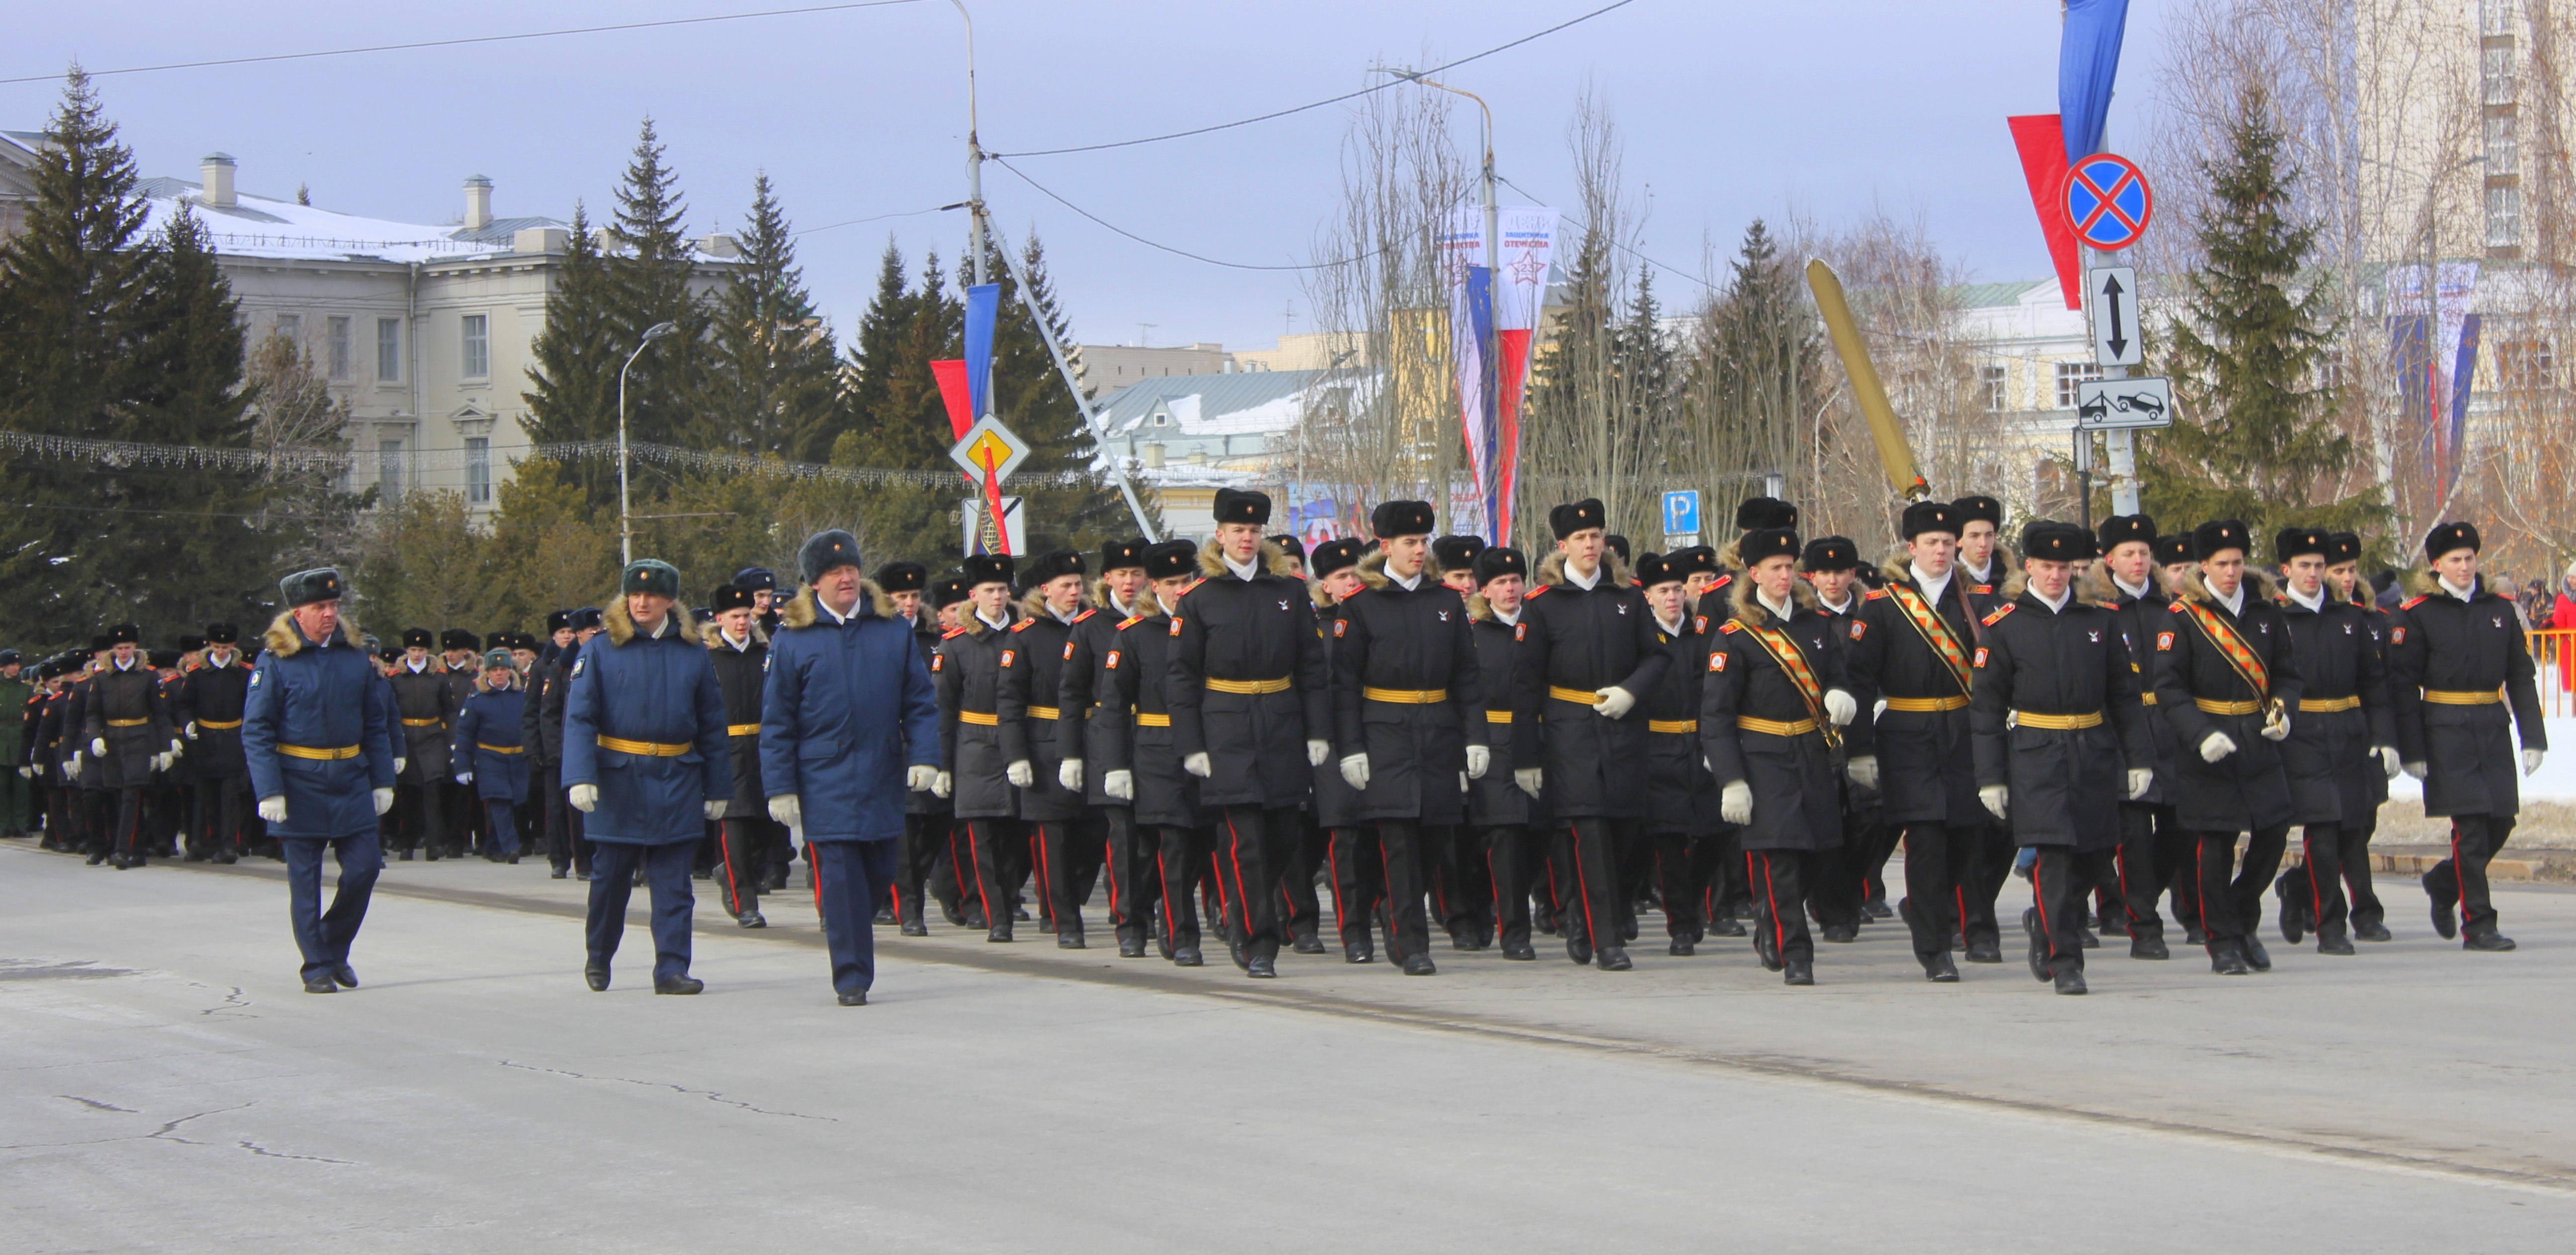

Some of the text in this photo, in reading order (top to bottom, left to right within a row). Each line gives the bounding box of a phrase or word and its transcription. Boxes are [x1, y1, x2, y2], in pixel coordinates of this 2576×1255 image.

[1506, 216, 1549, 230] ДЕНЬ
[1521, 264, 1533, 273] 23
[1670, 496, 1690, 530] P
